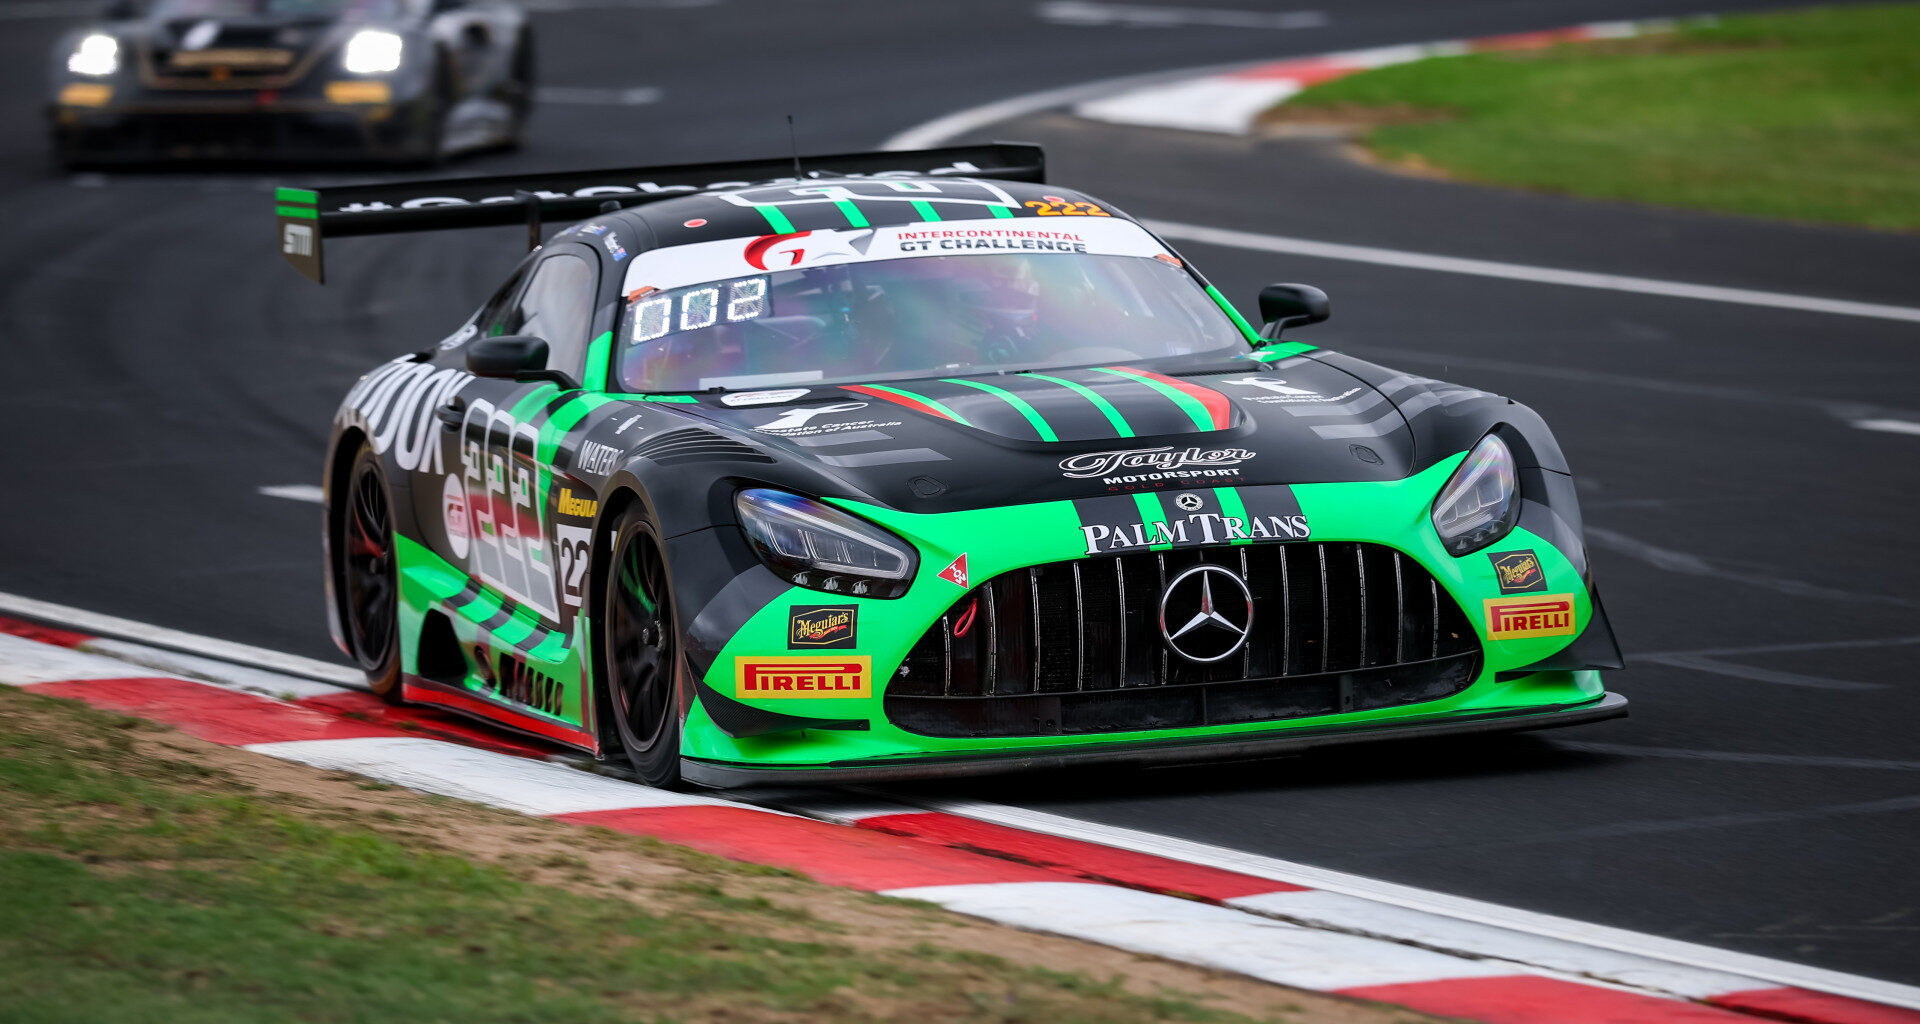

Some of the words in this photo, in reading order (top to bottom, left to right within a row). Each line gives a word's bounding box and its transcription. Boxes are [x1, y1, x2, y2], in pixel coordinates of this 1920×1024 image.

[1024, 200, 1112, 217] 222
[897, 230, 1084, 242] INTERCONTINENTAL
[900, 240, 932, 252] GT
[940, 239, 1088, 254] CHALLENGE
[632, 277, 767, 343] 002
[821, 419, 875, 429] Cancer
[578, 440, 624, 476] WATER
[1059, 446, 1257, 479] Taylor
[1103, 468, 1240, 485] MOTORSPORT
[1108, 482, 1164, 491] GOLD
[1180, 477, 1246, 485] COAST
[949, 563, 967, 585] TOW
[796, 612, 850, 640] Meguiar's
[1490, 601, 1570, 632] PIRELLI
[744, 663, 862, 691] PIRELLI
